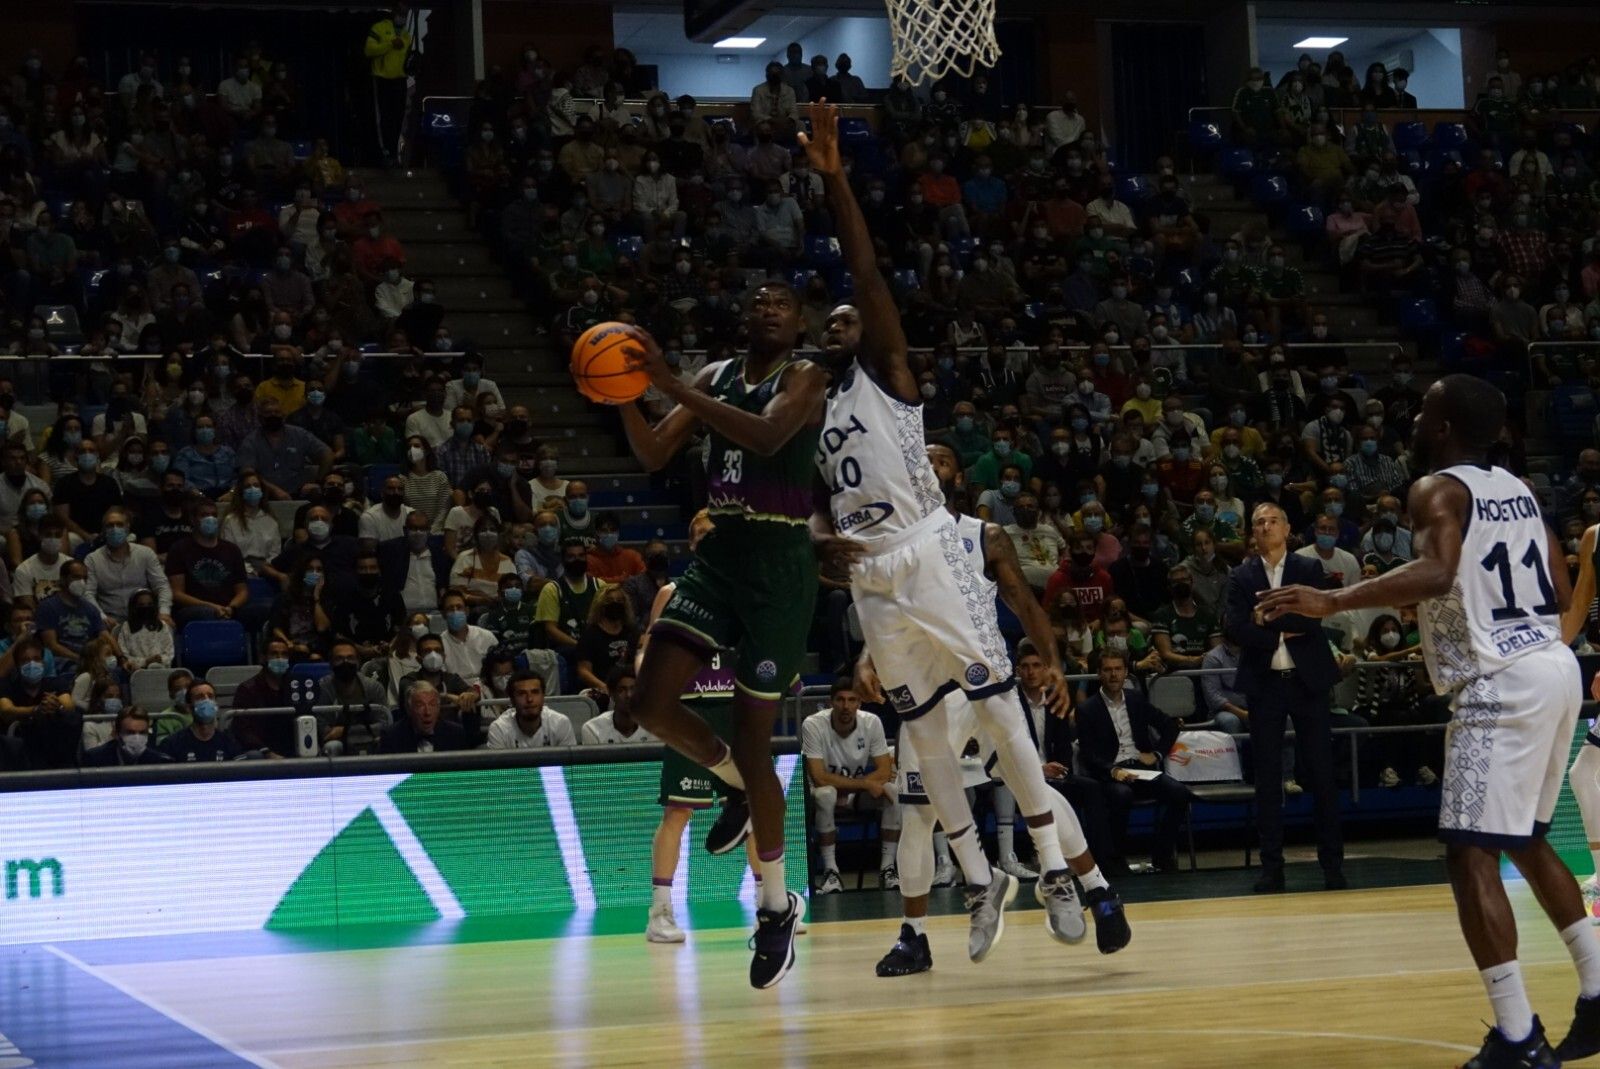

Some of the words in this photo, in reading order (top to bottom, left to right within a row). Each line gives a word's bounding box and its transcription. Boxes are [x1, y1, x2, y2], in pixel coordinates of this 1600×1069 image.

[722, 449, 743, 484] 33
[830, 456, 862, 496] 10
[1481, 539, 1560, 621] 11
[1496, 629, 1547, 654] DELIN
